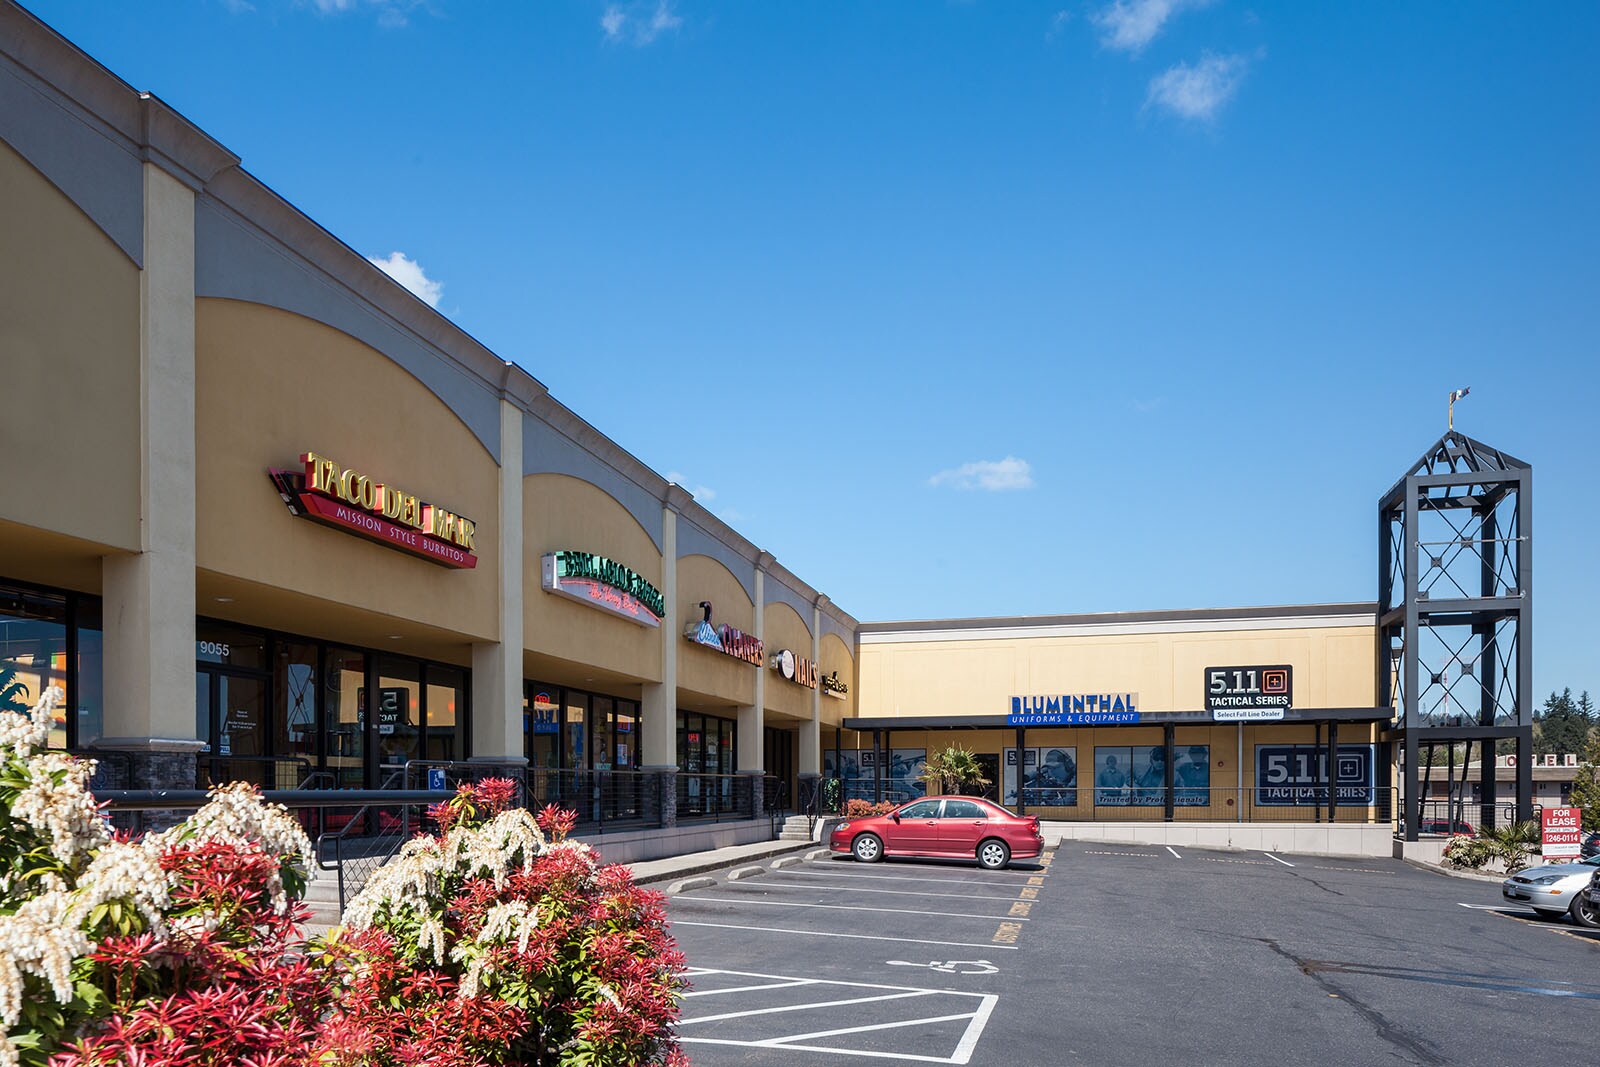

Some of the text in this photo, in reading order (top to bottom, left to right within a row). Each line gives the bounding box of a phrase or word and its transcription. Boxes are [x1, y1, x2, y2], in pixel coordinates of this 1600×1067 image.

[307, 452, 477, 550] TACO DEL MAR
[336, 507, 464, 562] MISSION STYLE BURRITOS
[200, 640, 230, 657] 9055
[723, 623, 764, 667] CLEANERS
[794, 654, 818, 689] NAILS
[1210, 671, 1260, 694] 5.11
[1012, 694, 1136, 714] BLUMENTHAL
[1210, 696, 1288, 706] TACTICAL SERIES
[1012, 715, 1061, 723] UNIFORMS
[1078, 713, 1135, 722] EQUIPMENT
[1133, 796, 1141, 804] by
[1552, 809, 1570, 817] FOR
[1546, 818, 1576, 826] LEASE
[1549, 834, 1578, 843] 246-0114
